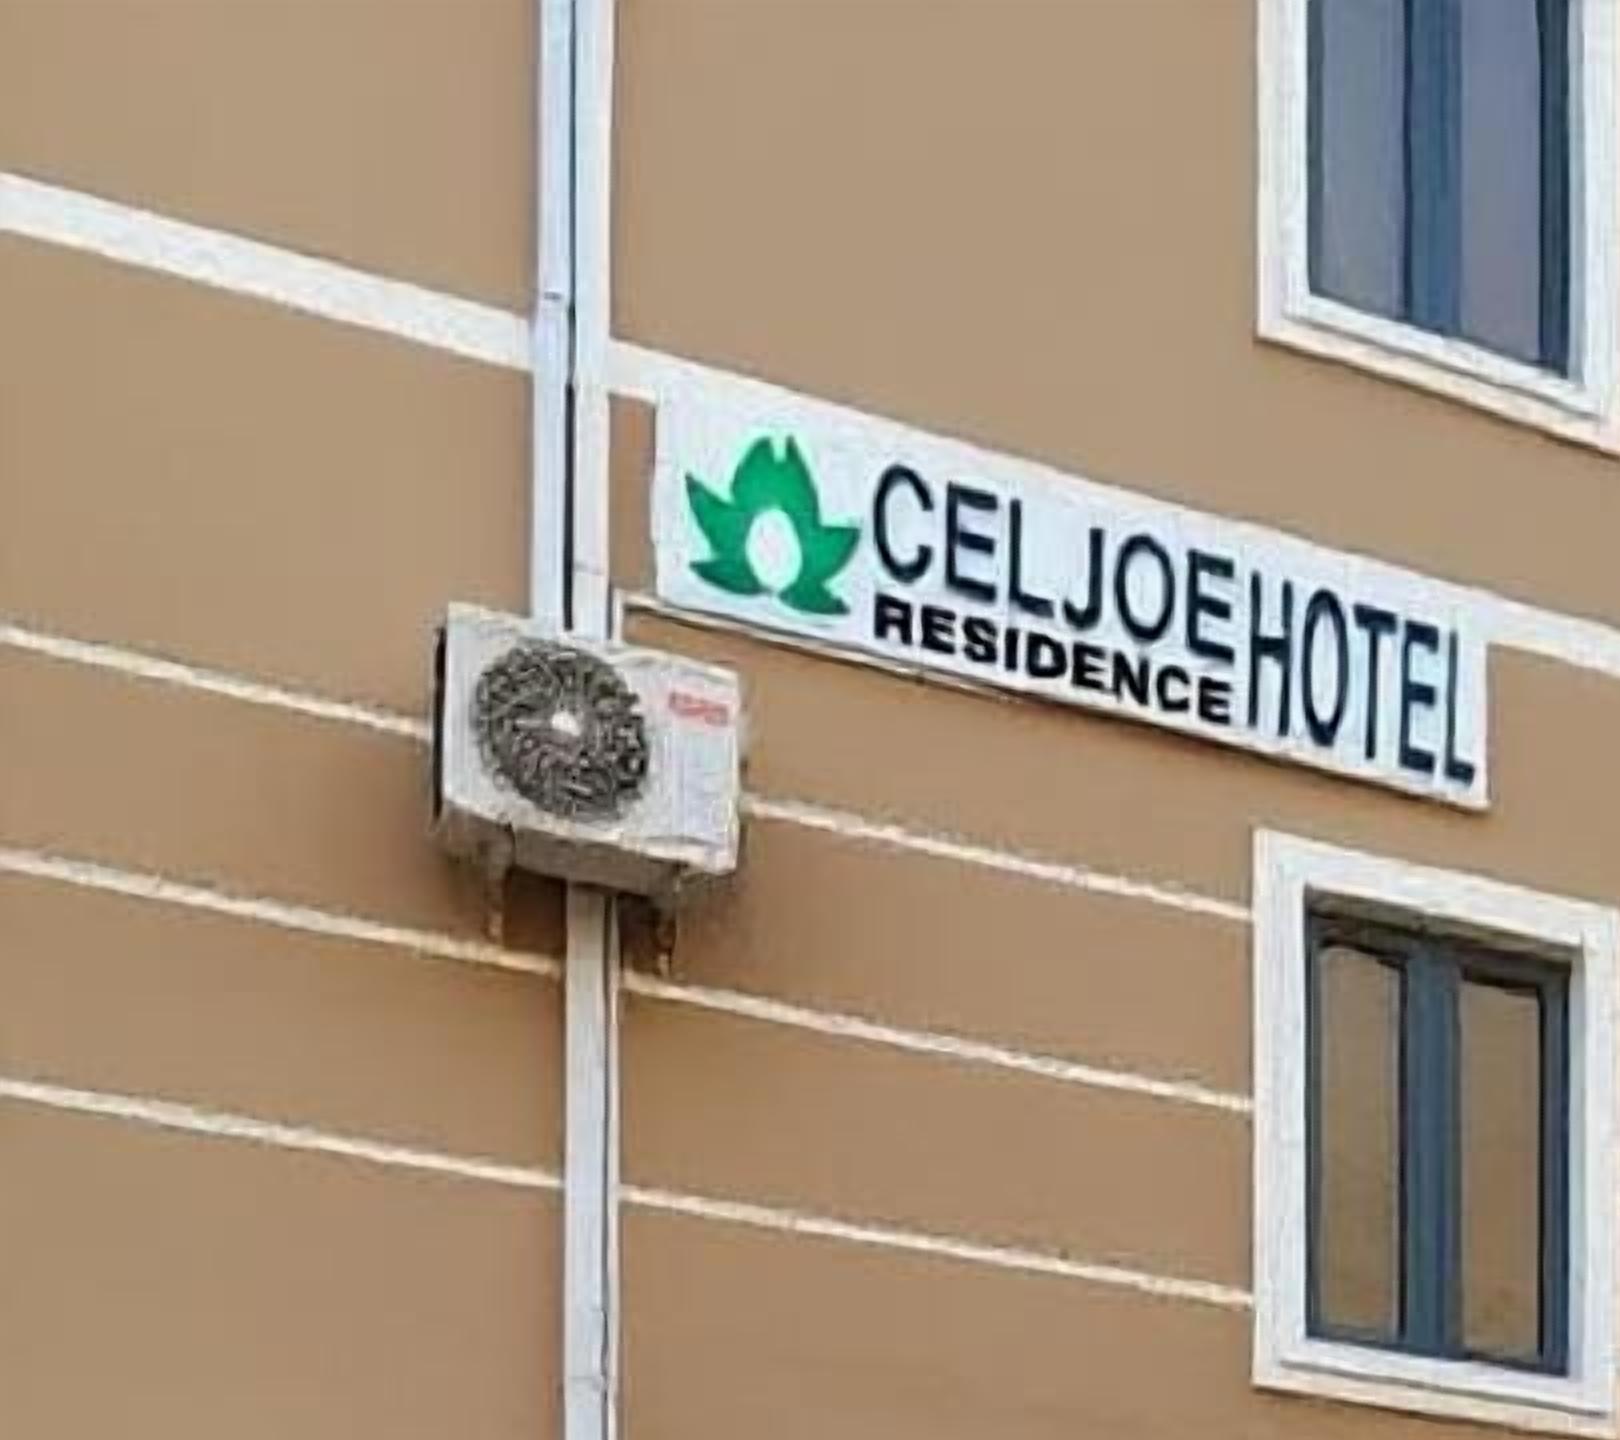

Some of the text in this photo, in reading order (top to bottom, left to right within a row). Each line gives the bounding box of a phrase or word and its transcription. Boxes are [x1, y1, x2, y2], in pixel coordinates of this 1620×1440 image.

[871, 595, 1232, 725] RESIDENCE
[872, 464, 1476, 784] CELJOE HOTEL
